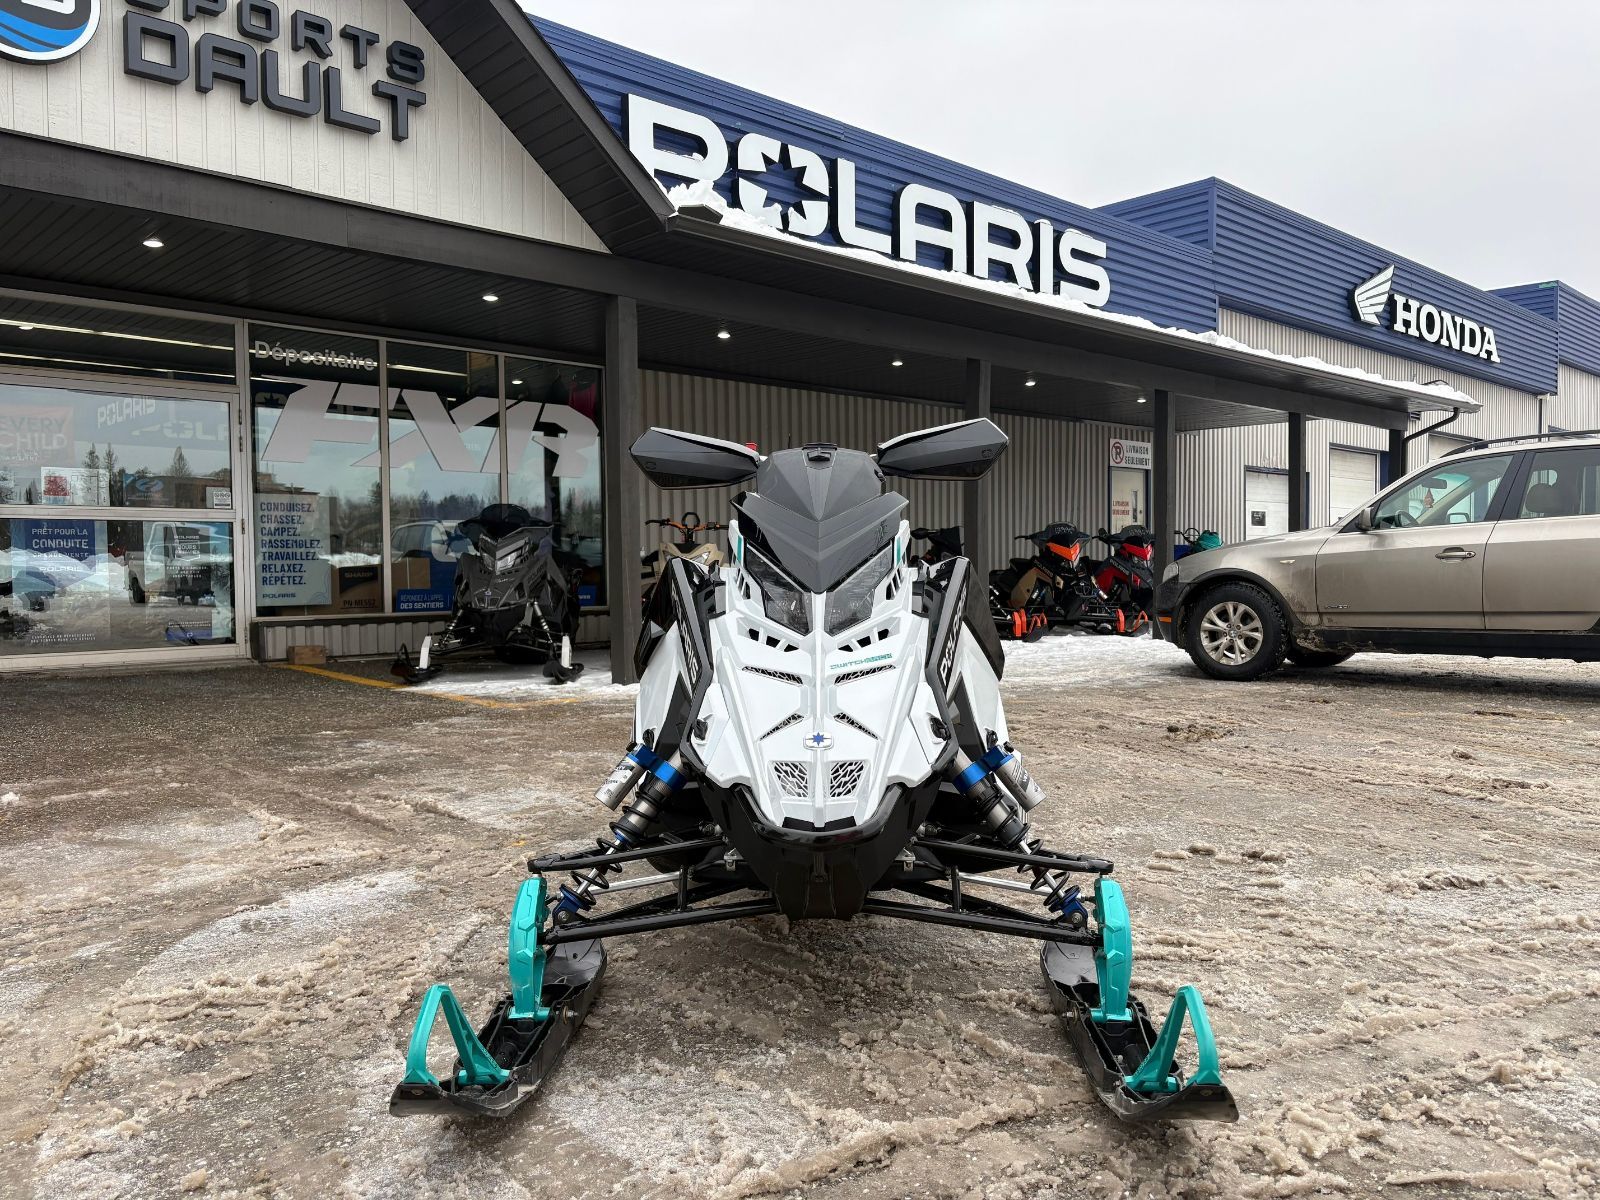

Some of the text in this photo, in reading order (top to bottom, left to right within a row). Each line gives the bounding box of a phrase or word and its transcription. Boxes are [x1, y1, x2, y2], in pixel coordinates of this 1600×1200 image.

[124, 10, 427, 142] DAULT
[625, 92, 1112, 308] POLARIS
[1391, 292, 1501, 364] HONDA
[254, 340, 376, 372] Dépositaire
[260, 376, 601, 478] FXR
[1125, 444, 1149, 455] LIVRAISON
[1124, 455, 1150, 467] SEULEMENT
[260, 502, 315, 513] CONDUISEZ.
[260, 514, 305, 524] CHASSEZ.
[260, 526, 301, 537] CAMPEZ.
[32, 538, 89, 549] CONDUITE
[261, 539, 323, 549] RASSEMBLEZ.
[261, 551, 319, 561] TRAVAILLEZ.
[261, 563, 306, 573] RELAXEZ.
[261, 574, 306, 586] RÉPÉTEZ.
[413, 601, 444, 609] SENTIERS
